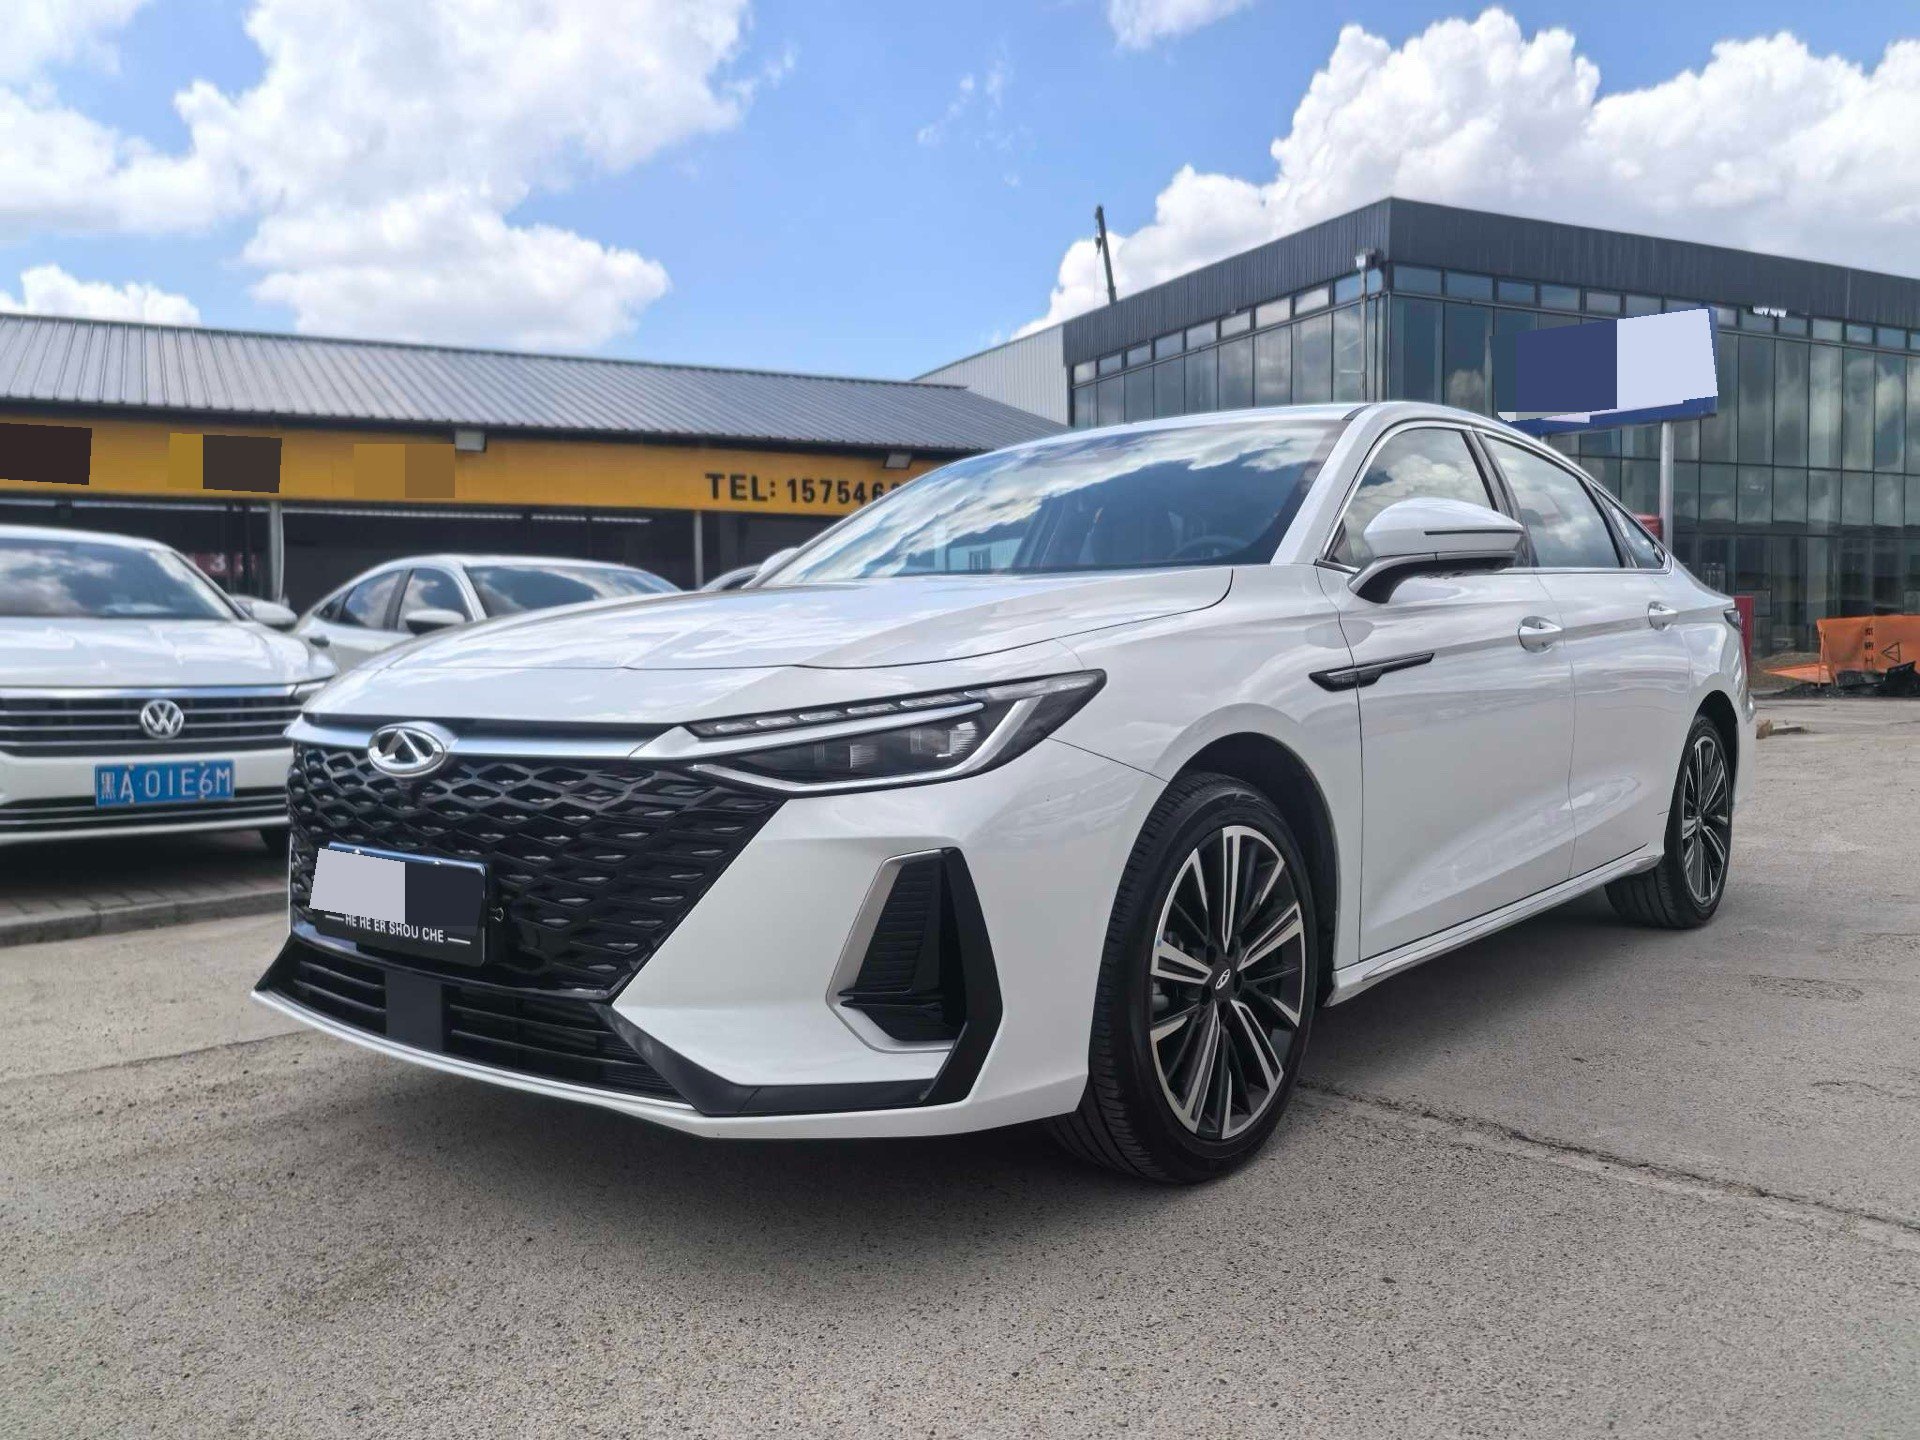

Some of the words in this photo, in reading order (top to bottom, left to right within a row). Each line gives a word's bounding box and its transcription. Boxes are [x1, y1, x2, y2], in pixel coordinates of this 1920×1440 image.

[705, 473, 776, 501] TEL:
[345, 914, 358, 928] HE
[360, 916, 372, 931] HE
[374, 918, 387, 933] ER
[389, 921, 419, 939] SHOU
[422, 926, 444, 943] CHE
